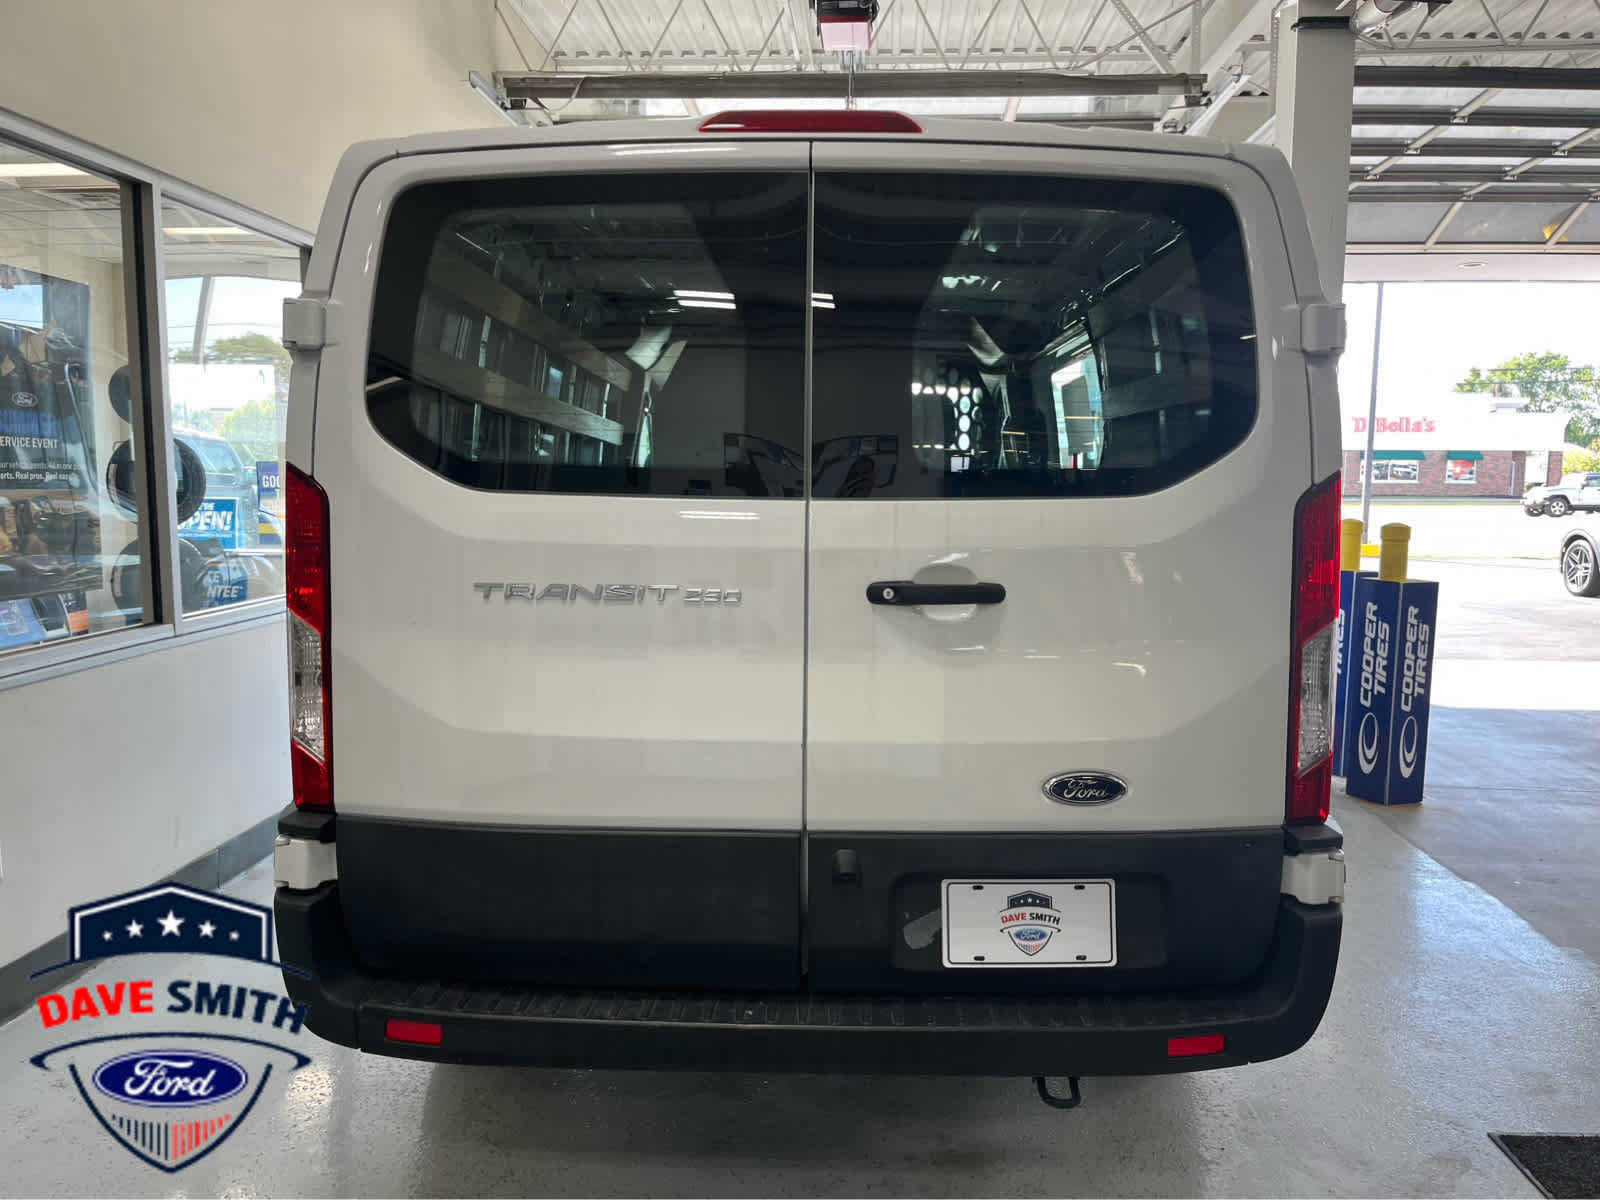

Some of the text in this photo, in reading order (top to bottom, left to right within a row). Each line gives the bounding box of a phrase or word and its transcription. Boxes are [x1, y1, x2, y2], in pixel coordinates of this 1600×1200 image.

[0, 436, 58, 449] ERVICE EVENT
[178, 510, 233, 531] PEN!
[473, 582, 742, 603] TRANSIT 250
[1360, 601, 1378, 708] COOPER
[1373, 620, 1390, 696] TIRES
[1401, 605, 1419, 713] COOPER
[1413, 623, 1430, 698] TIRES
[1063, 778, 1108, 799] Ford
[1001, 912, 1061, 925] DAVE SMITH
